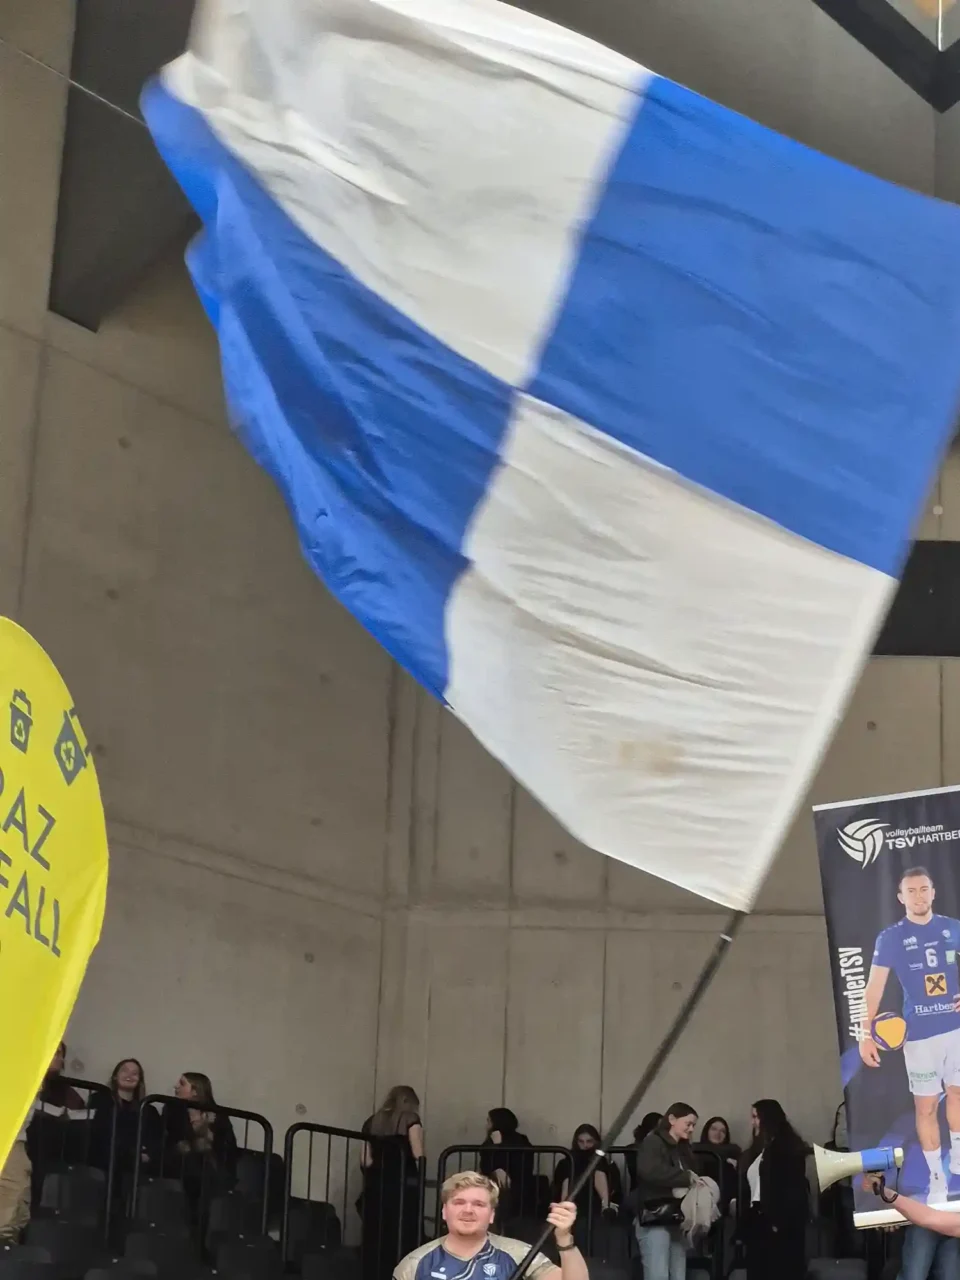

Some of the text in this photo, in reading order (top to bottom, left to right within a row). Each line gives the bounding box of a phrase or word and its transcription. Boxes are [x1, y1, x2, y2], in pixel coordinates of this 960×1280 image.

[0, 768, 56, 871] AZ
[885, 824, 943, 838] volleyballteam
[885, 836, 917, 850] TSV
[925, 948, 938, 968] 6
